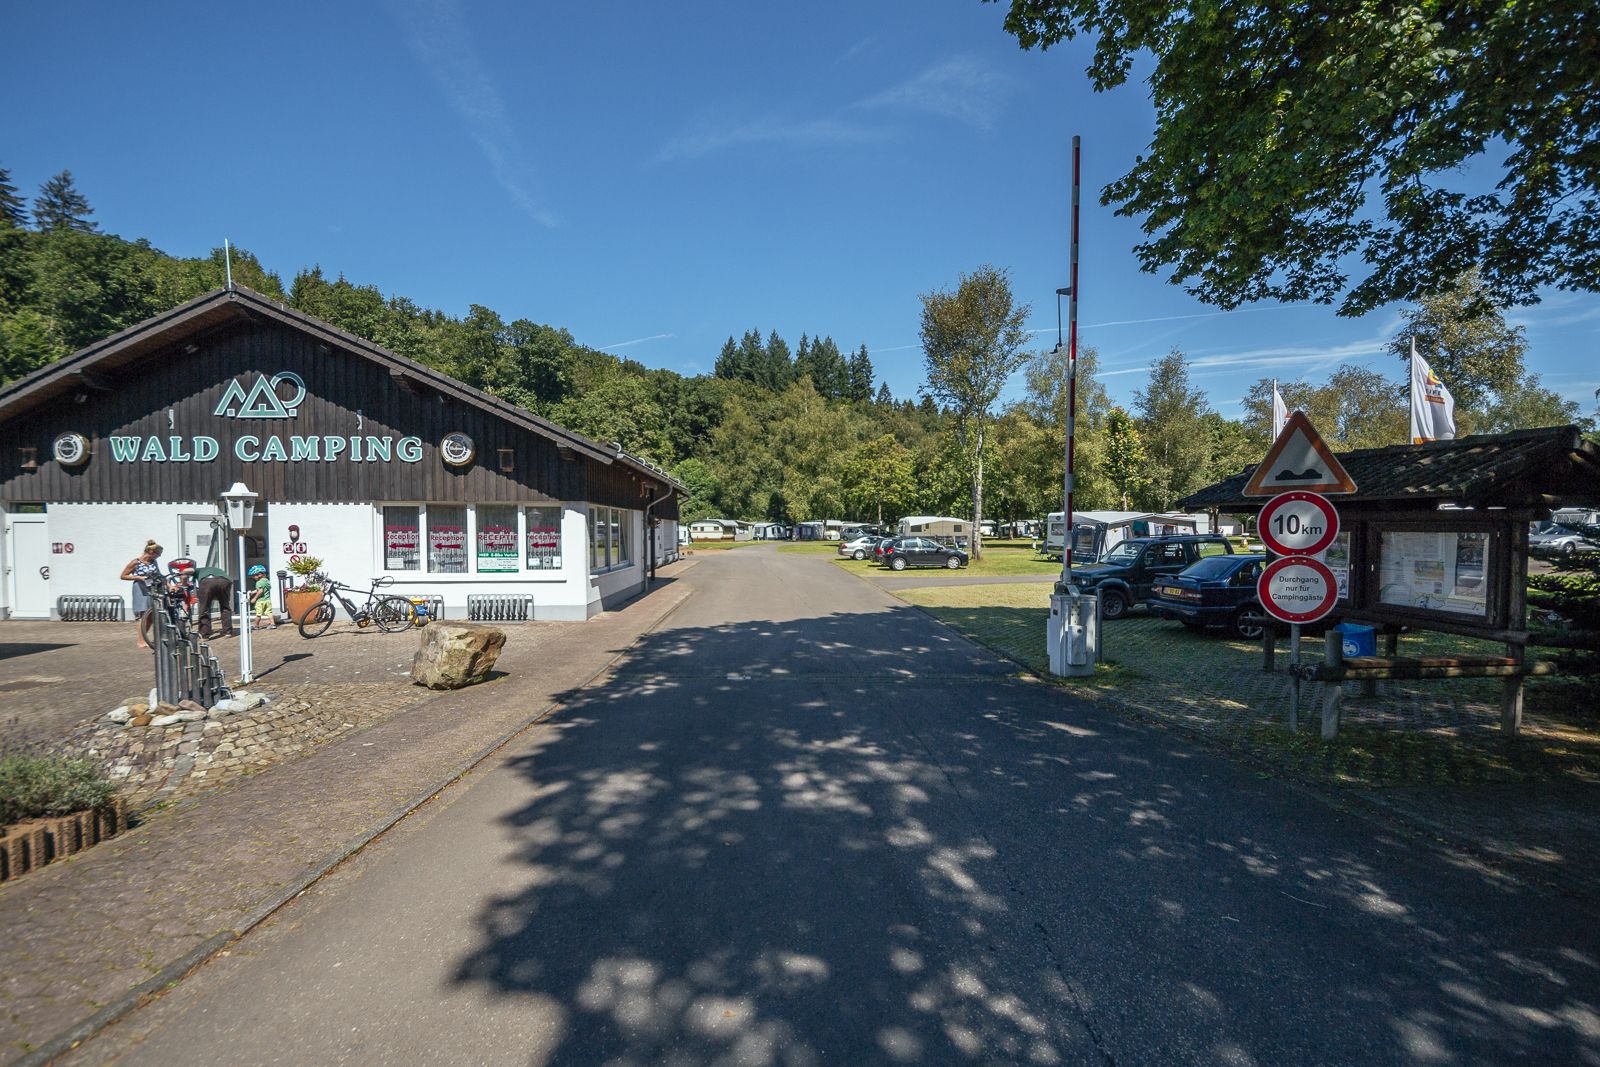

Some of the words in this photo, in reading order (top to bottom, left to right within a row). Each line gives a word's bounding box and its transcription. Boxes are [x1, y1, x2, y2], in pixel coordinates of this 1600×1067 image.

[110, 435, 219, 463] WALD
[234, 435, 424, 463] CAMPING
[1274, 514, 1300, 535] 10
[1301, 524, 1322, 535] km
[384, 533, 420, 541] Reception
[430, 534, 465, 542] Reception
[477, 533, 519, 541] RECEPTIE
[1299, 584, 1310, 592] für
[1272, 593, 1323, 602] Campinggäste
